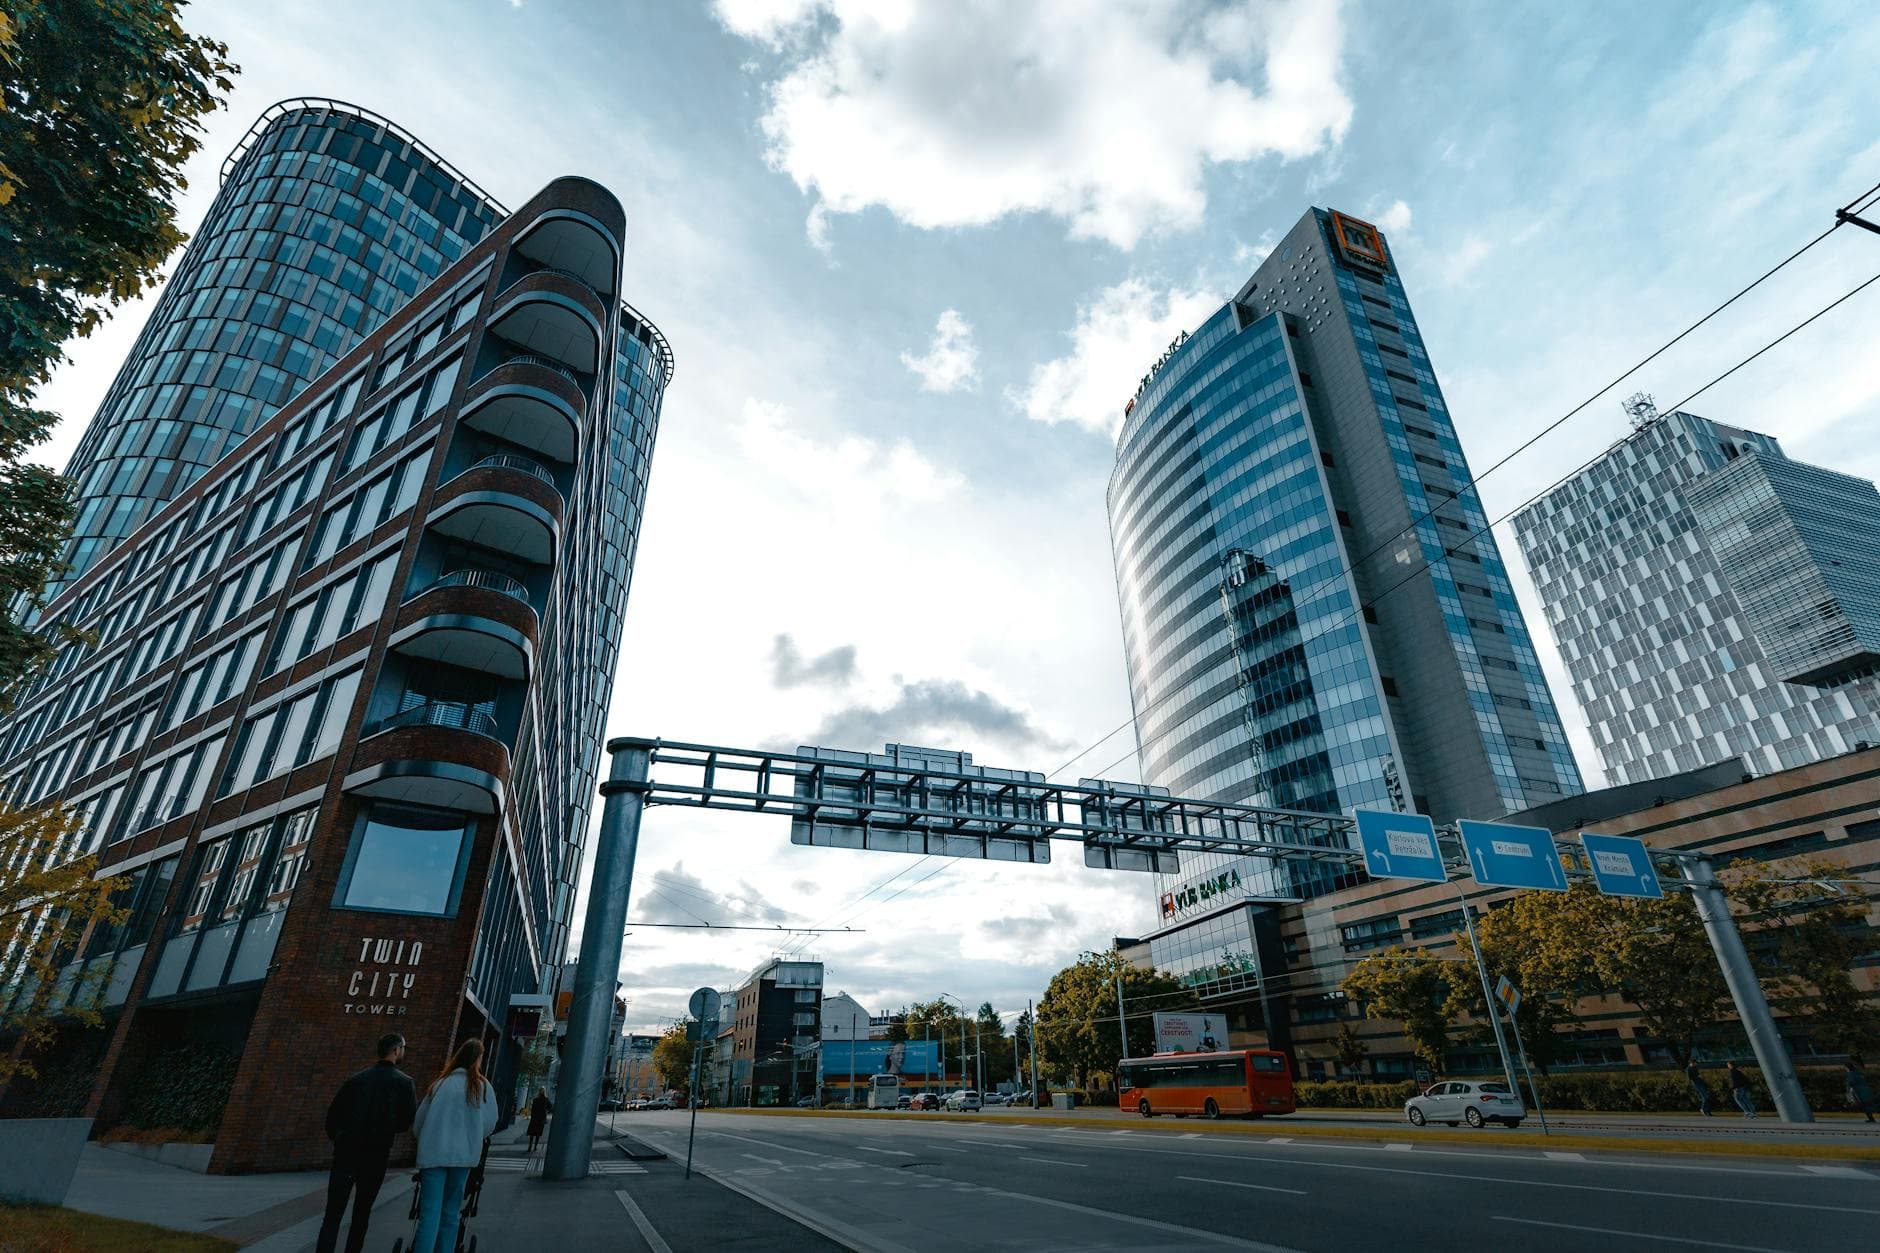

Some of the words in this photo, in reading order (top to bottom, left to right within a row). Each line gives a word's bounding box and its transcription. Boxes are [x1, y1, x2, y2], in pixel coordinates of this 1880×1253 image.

[1394, 844, 1427, 855] Petržalka
[1503, 843, 1529, 854] Centrum
[1175, 884, 1198, 910] VÚB
[1199, 868, 1241, 899] BANKA
[359, 937, 423, 966] TWIN
[348, 971, 416, 999] CITY
[344, 1004, 408, 1015] TOWER
